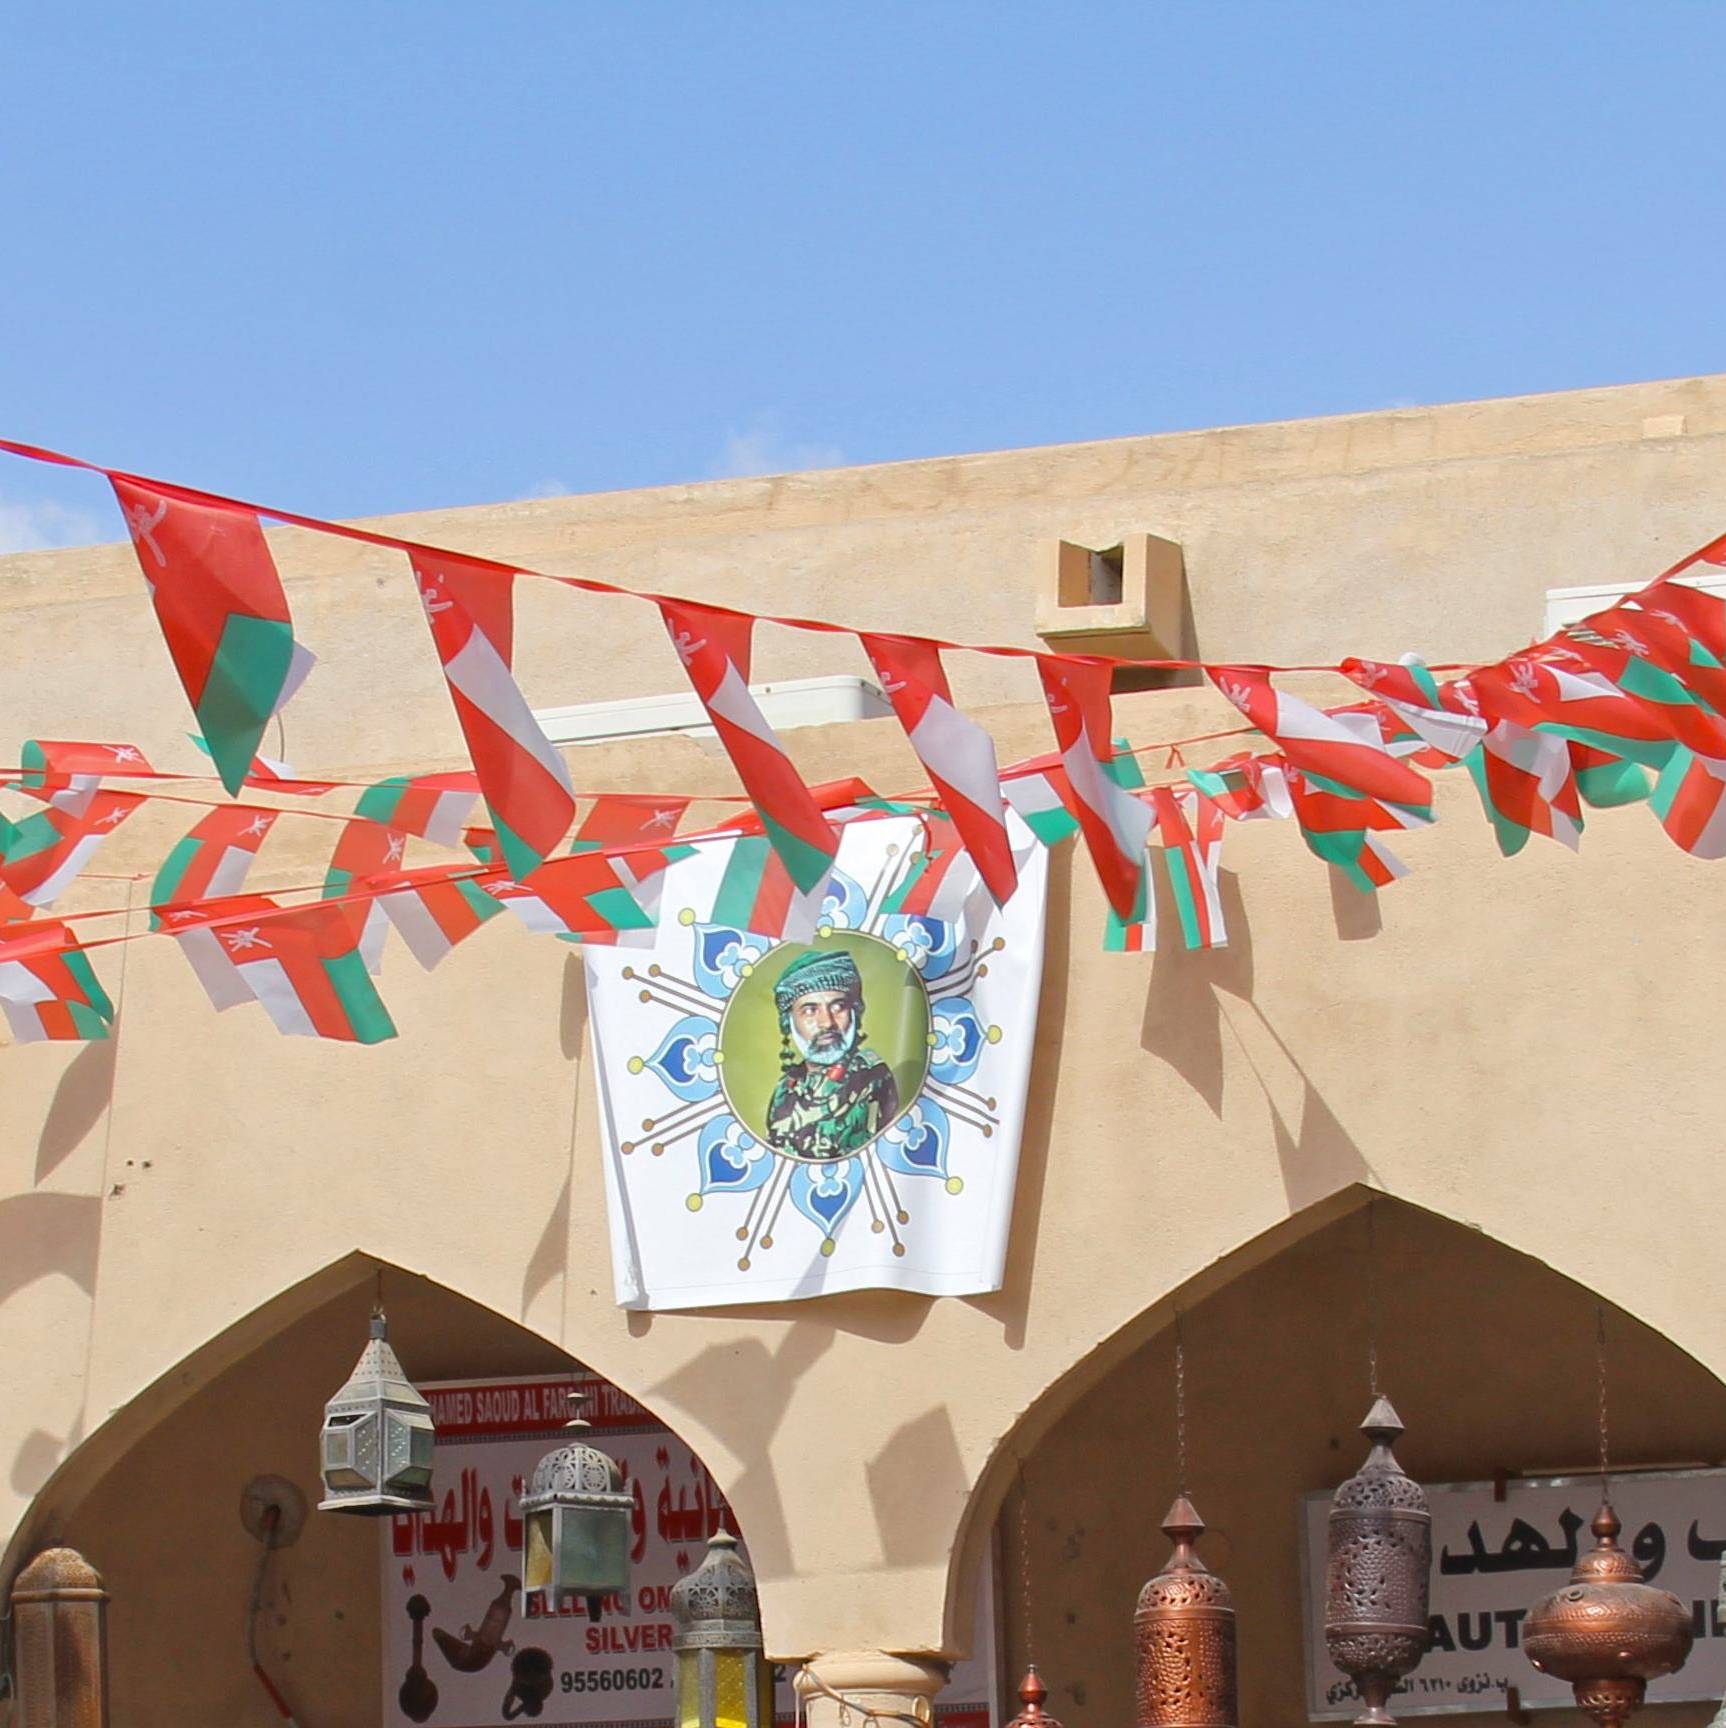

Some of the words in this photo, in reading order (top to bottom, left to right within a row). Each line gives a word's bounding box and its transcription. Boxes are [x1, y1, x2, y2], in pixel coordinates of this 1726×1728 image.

[476, 1389, 520, 1423] SAOUD
[523, 1388, 540, 1421] AL
[585, 1623, 674, 1654] SILVER
[559, 1666, 663, 1694] 95560602
